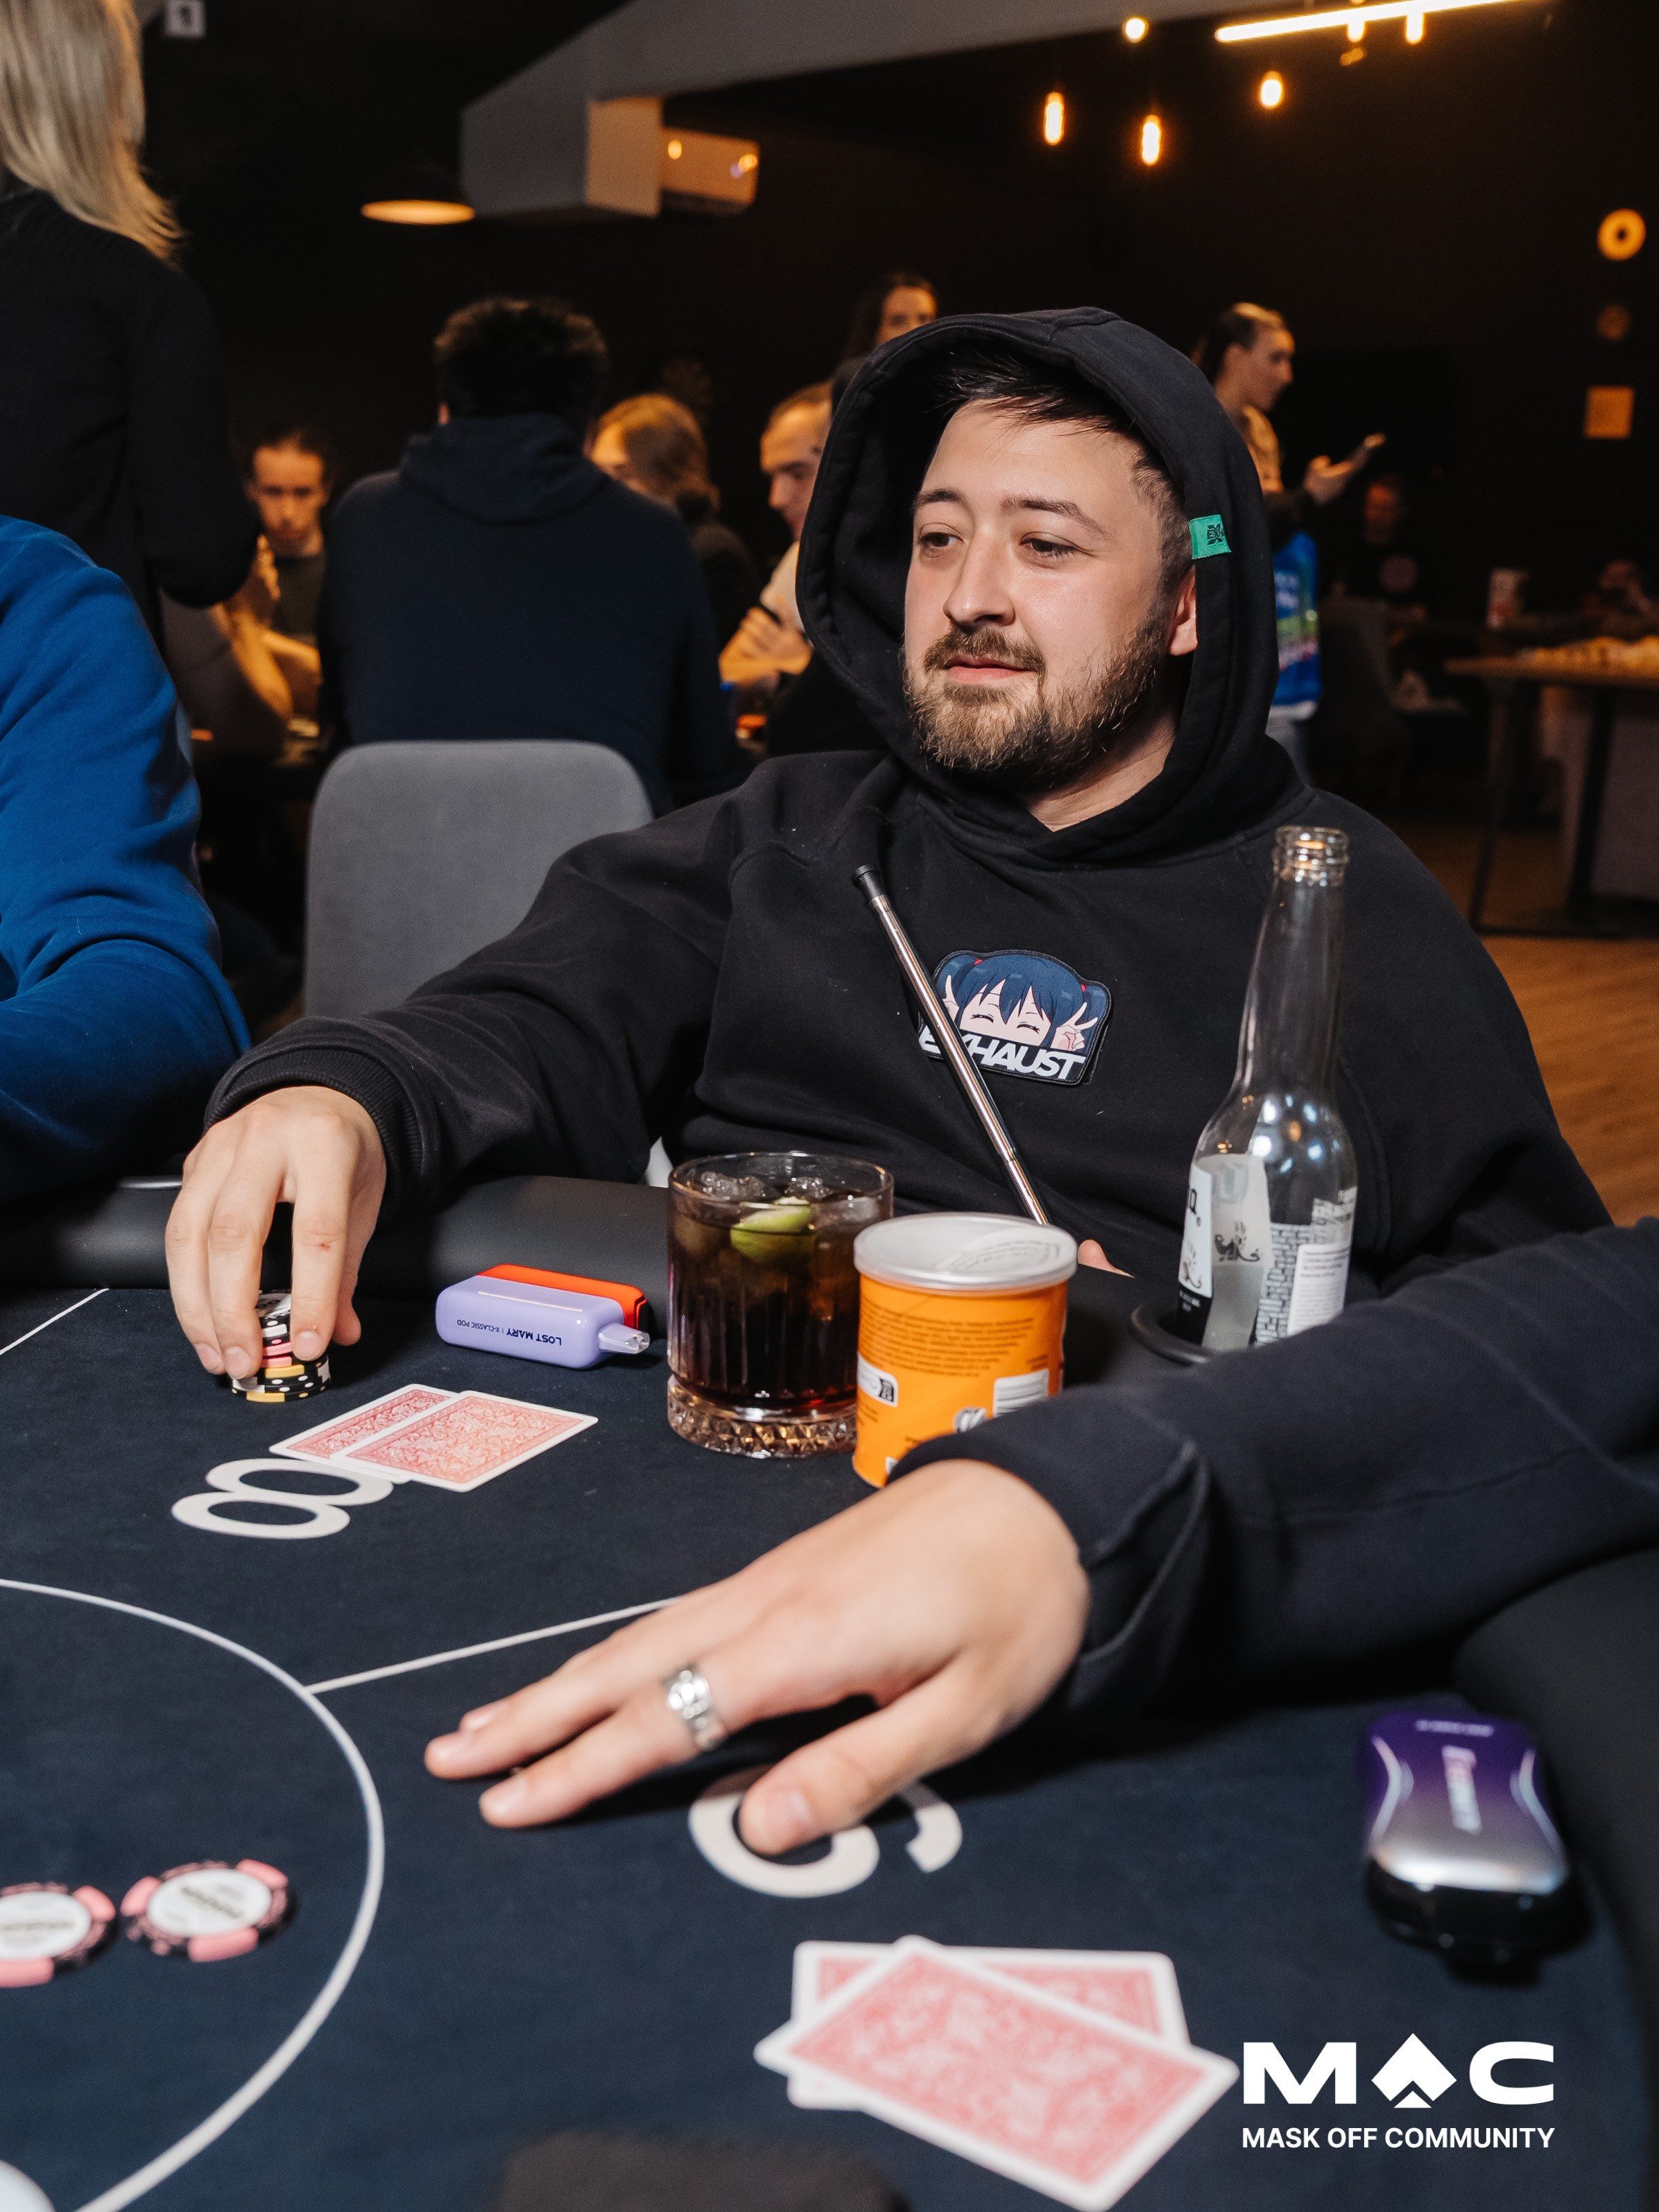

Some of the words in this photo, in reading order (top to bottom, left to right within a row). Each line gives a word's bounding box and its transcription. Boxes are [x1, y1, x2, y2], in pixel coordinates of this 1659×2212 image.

[919, 1025, 1086, 1080] EHAUST
[472, 1321, 500, 1333] X-CLASSIC
[506, 1328, 533, 1340] MARY
[535, 1333, 562, 1346] LOST
[171, 1457, 394, 1540] 8
